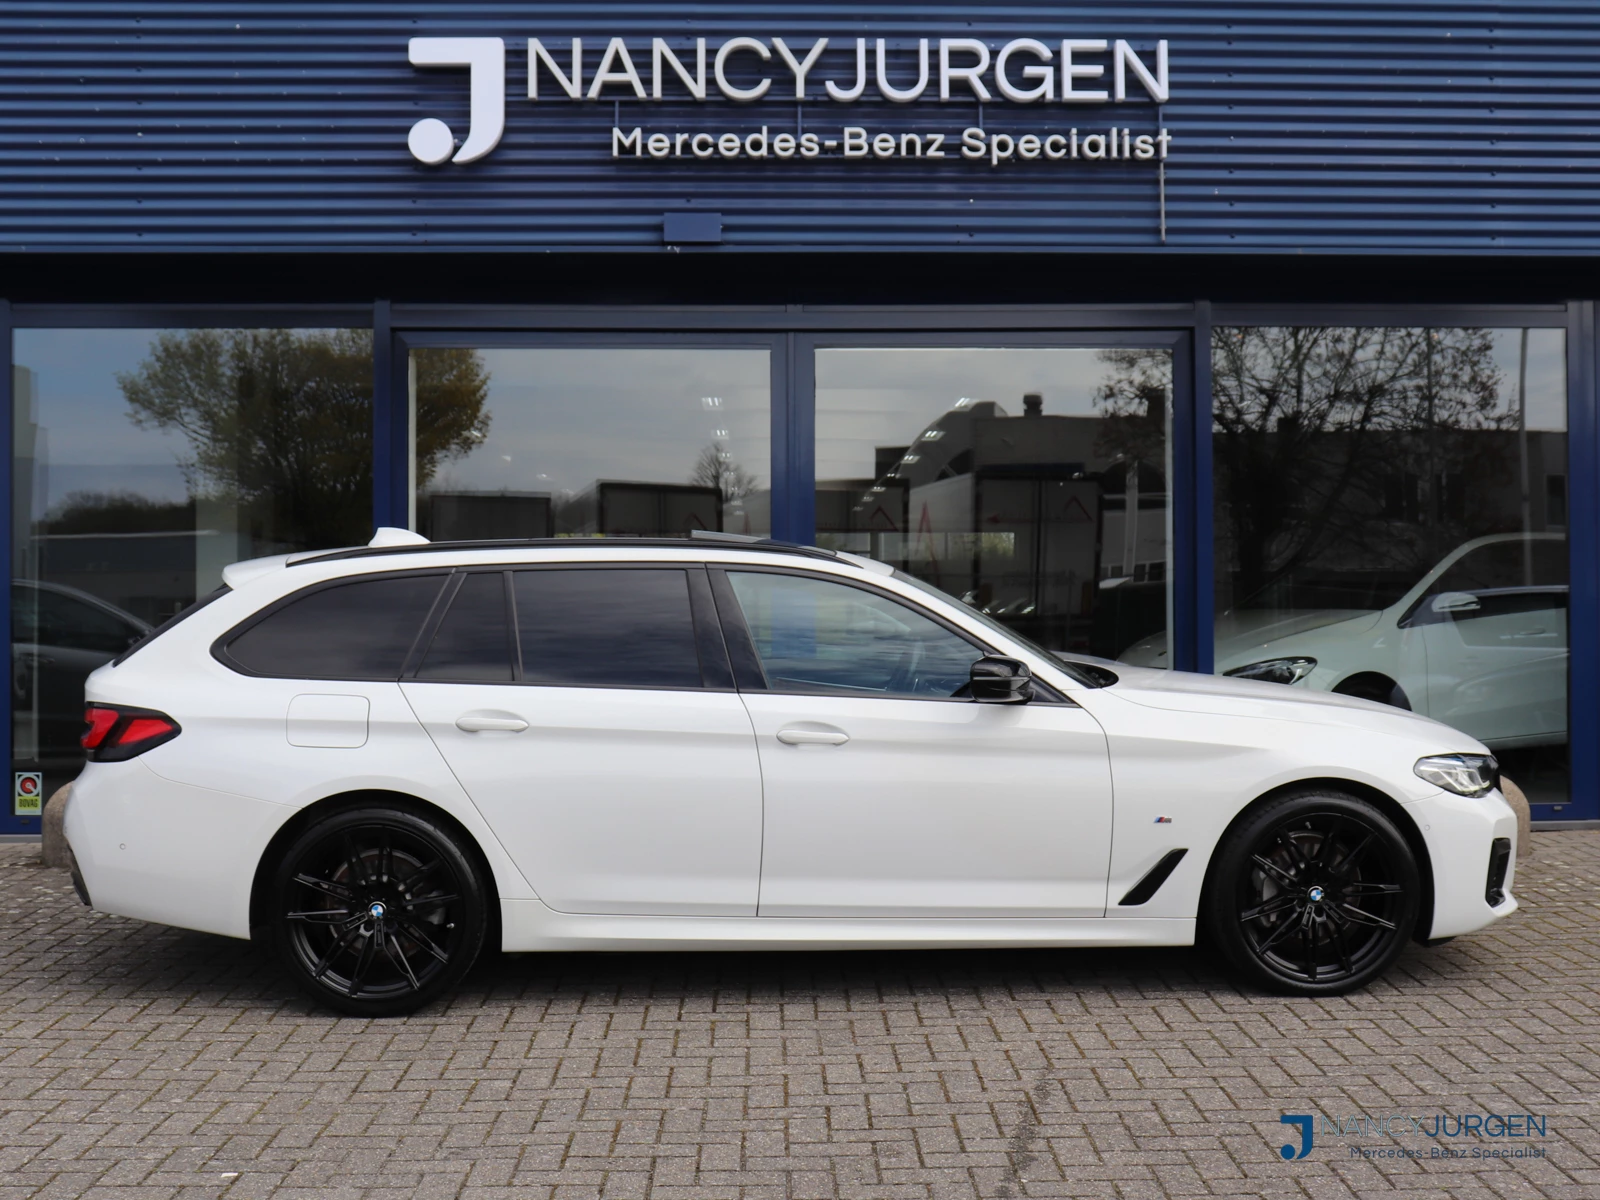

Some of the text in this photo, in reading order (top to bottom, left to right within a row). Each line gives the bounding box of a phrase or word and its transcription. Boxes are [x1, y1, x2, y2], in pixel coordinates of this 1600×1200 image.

[611, 124, 1174, 166] Mercedes-Benz Specialist
[18, 798, 38, 808] BOVAG
